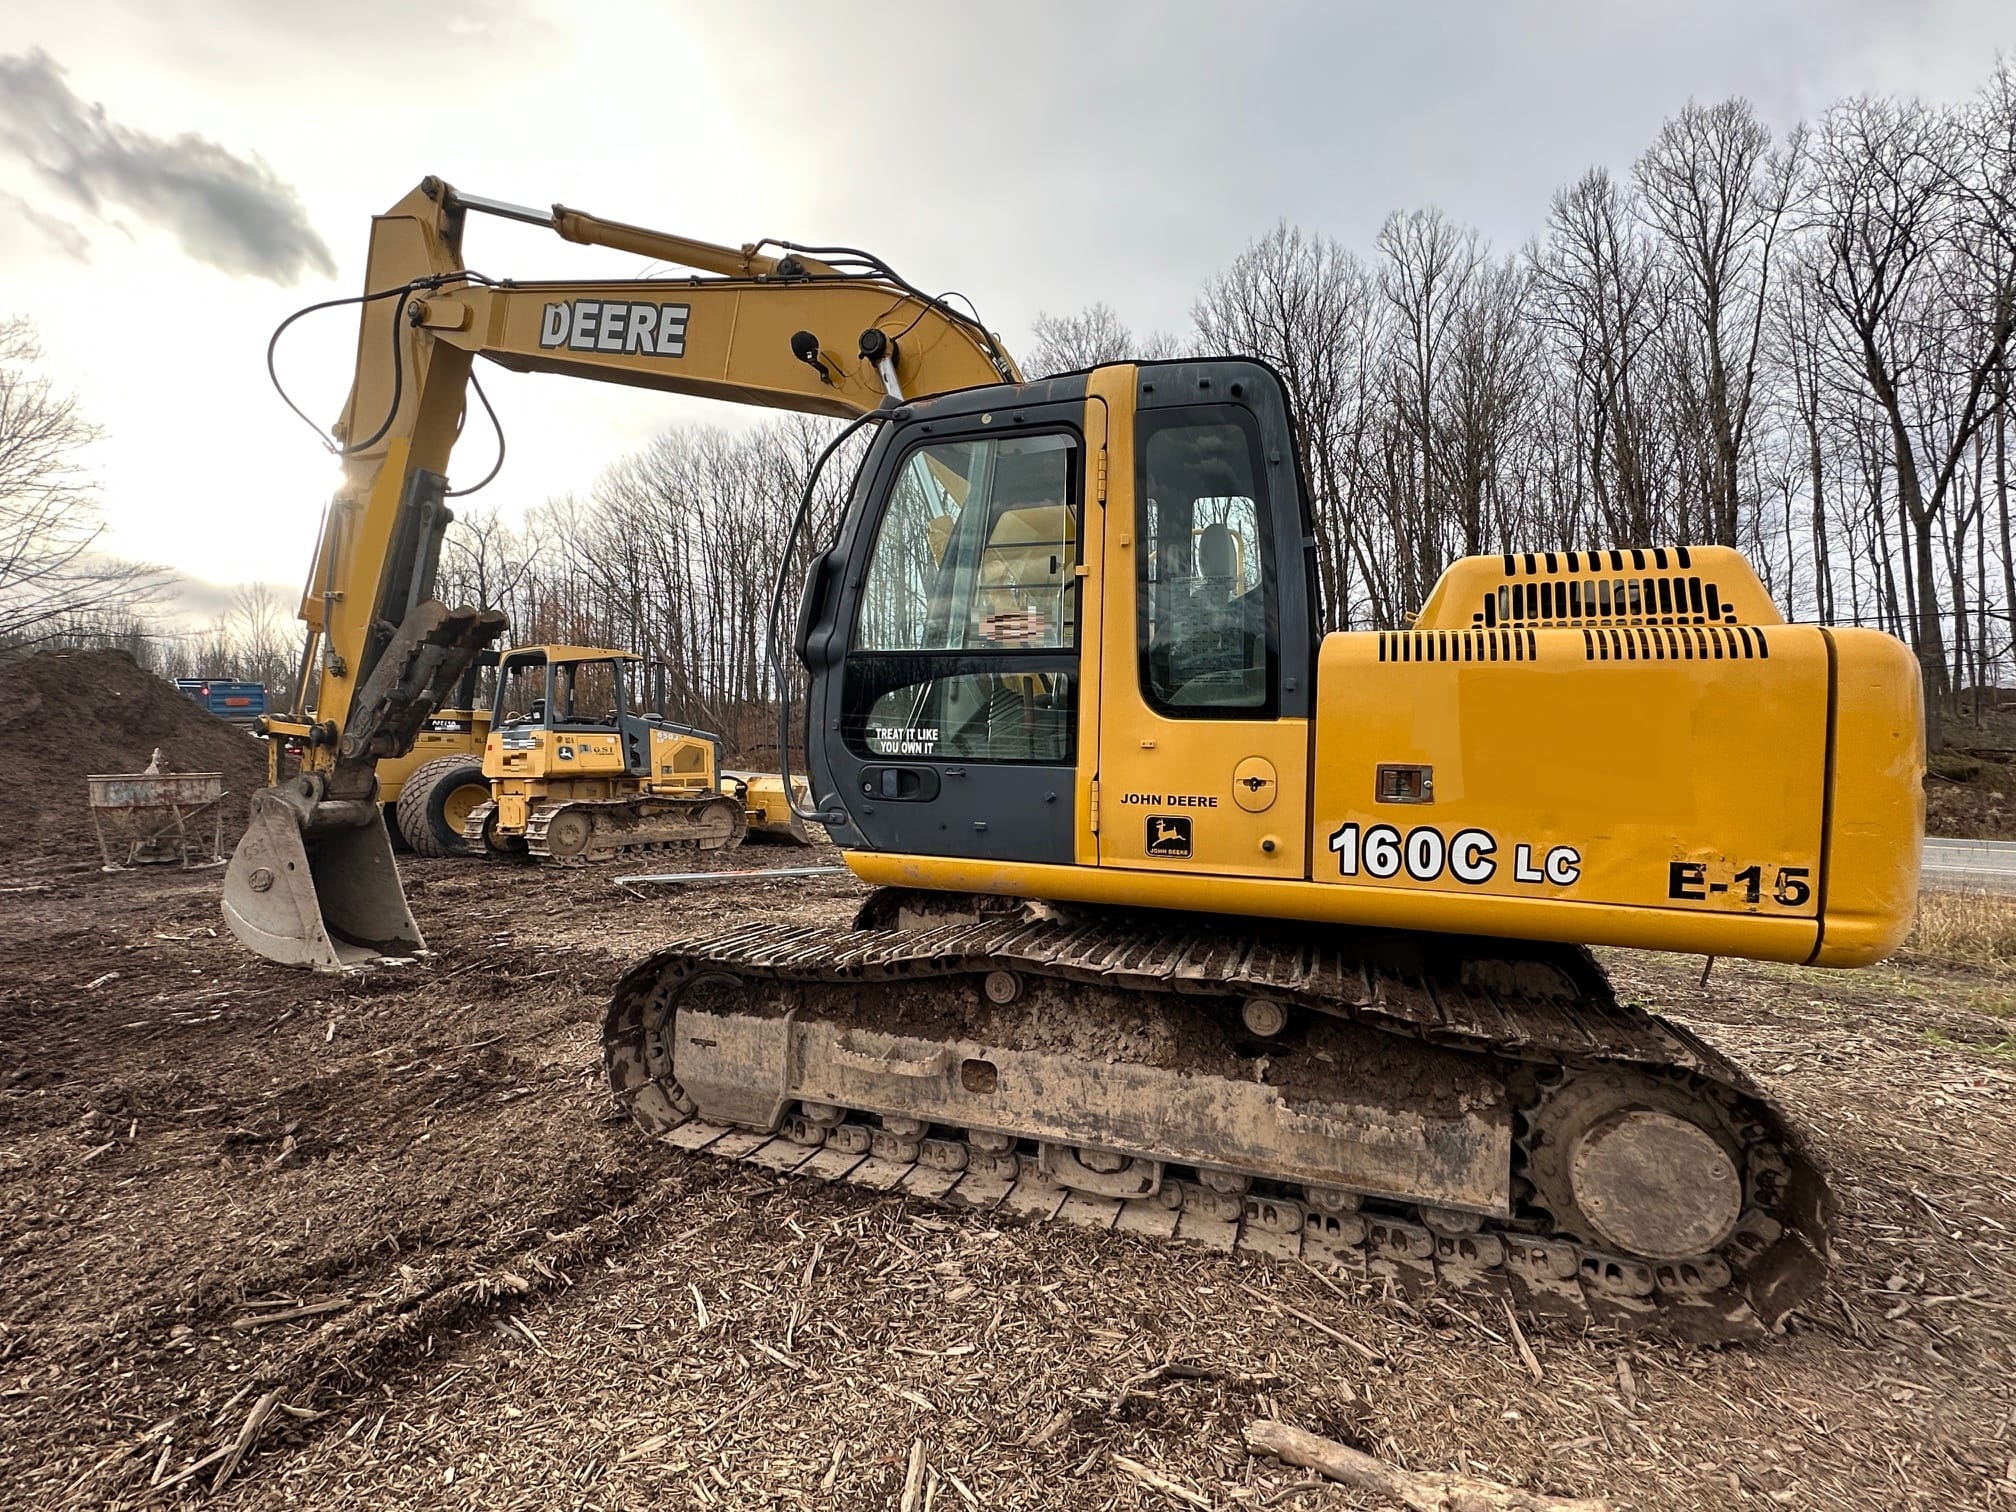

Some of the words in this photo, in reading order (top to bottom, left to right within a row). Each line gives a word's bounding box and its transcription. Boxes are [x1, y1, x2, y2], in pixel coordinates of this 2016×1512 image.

[540, 299, 691, 358] DEERE
[875, 728, 904, 740] TREAT
[905, 728, 915, 741] IT
[917, 728, 939, 741] LIKE
[880, 741, 899, 753] YOU
[901, 741, 922, 754] OWN
[924, 742, 934, 754] IT
[1120, 794, 1162, 805] JOHN
[1167, 795, 1218, 807] DEERE
[1329, 822, 1497, 885] 160C
[1514, 843, 1581, 886] LC
[1669, 862, 1811, 906] E-15
